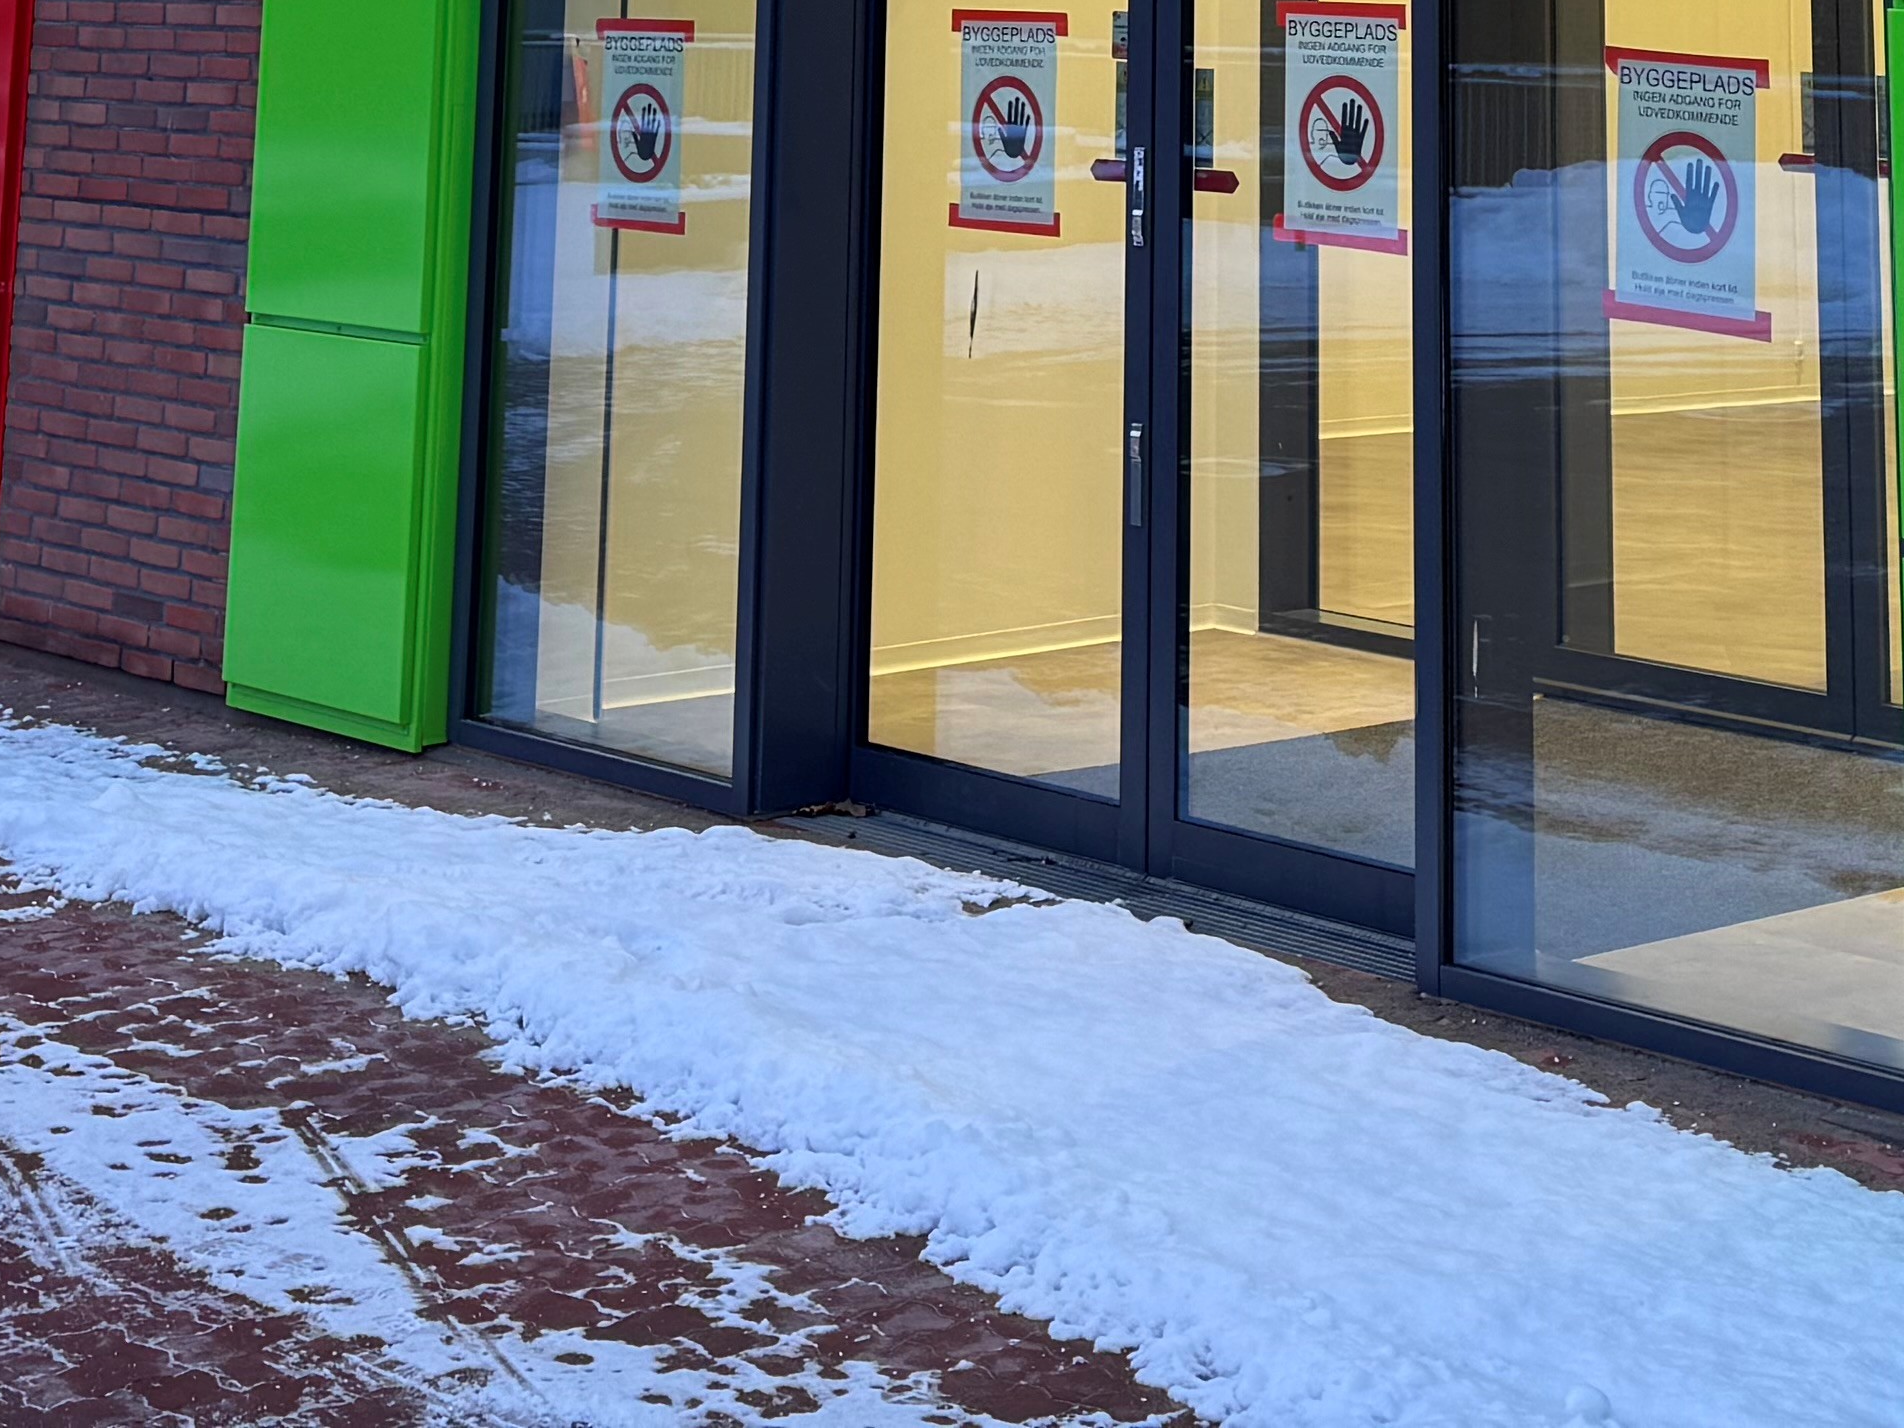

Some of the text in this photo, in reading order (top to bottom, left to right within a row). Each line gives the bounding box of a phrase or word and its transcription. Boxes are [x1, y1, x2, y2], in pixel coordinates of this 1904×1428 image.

[963, 26, 1055, 43] BYGGEPLADS
[1288, 20, 1398, 41] BYGGEPLADS
[605, 36, 684, 52] BYGGEPLADS
[1298, 41, 1386, 54] INGEN ADGANG FOR
[1620, 65, 1755, 96] BYGGEPLADS
[1632, 91, 1741, 110] INGEN ADGANG FOR
